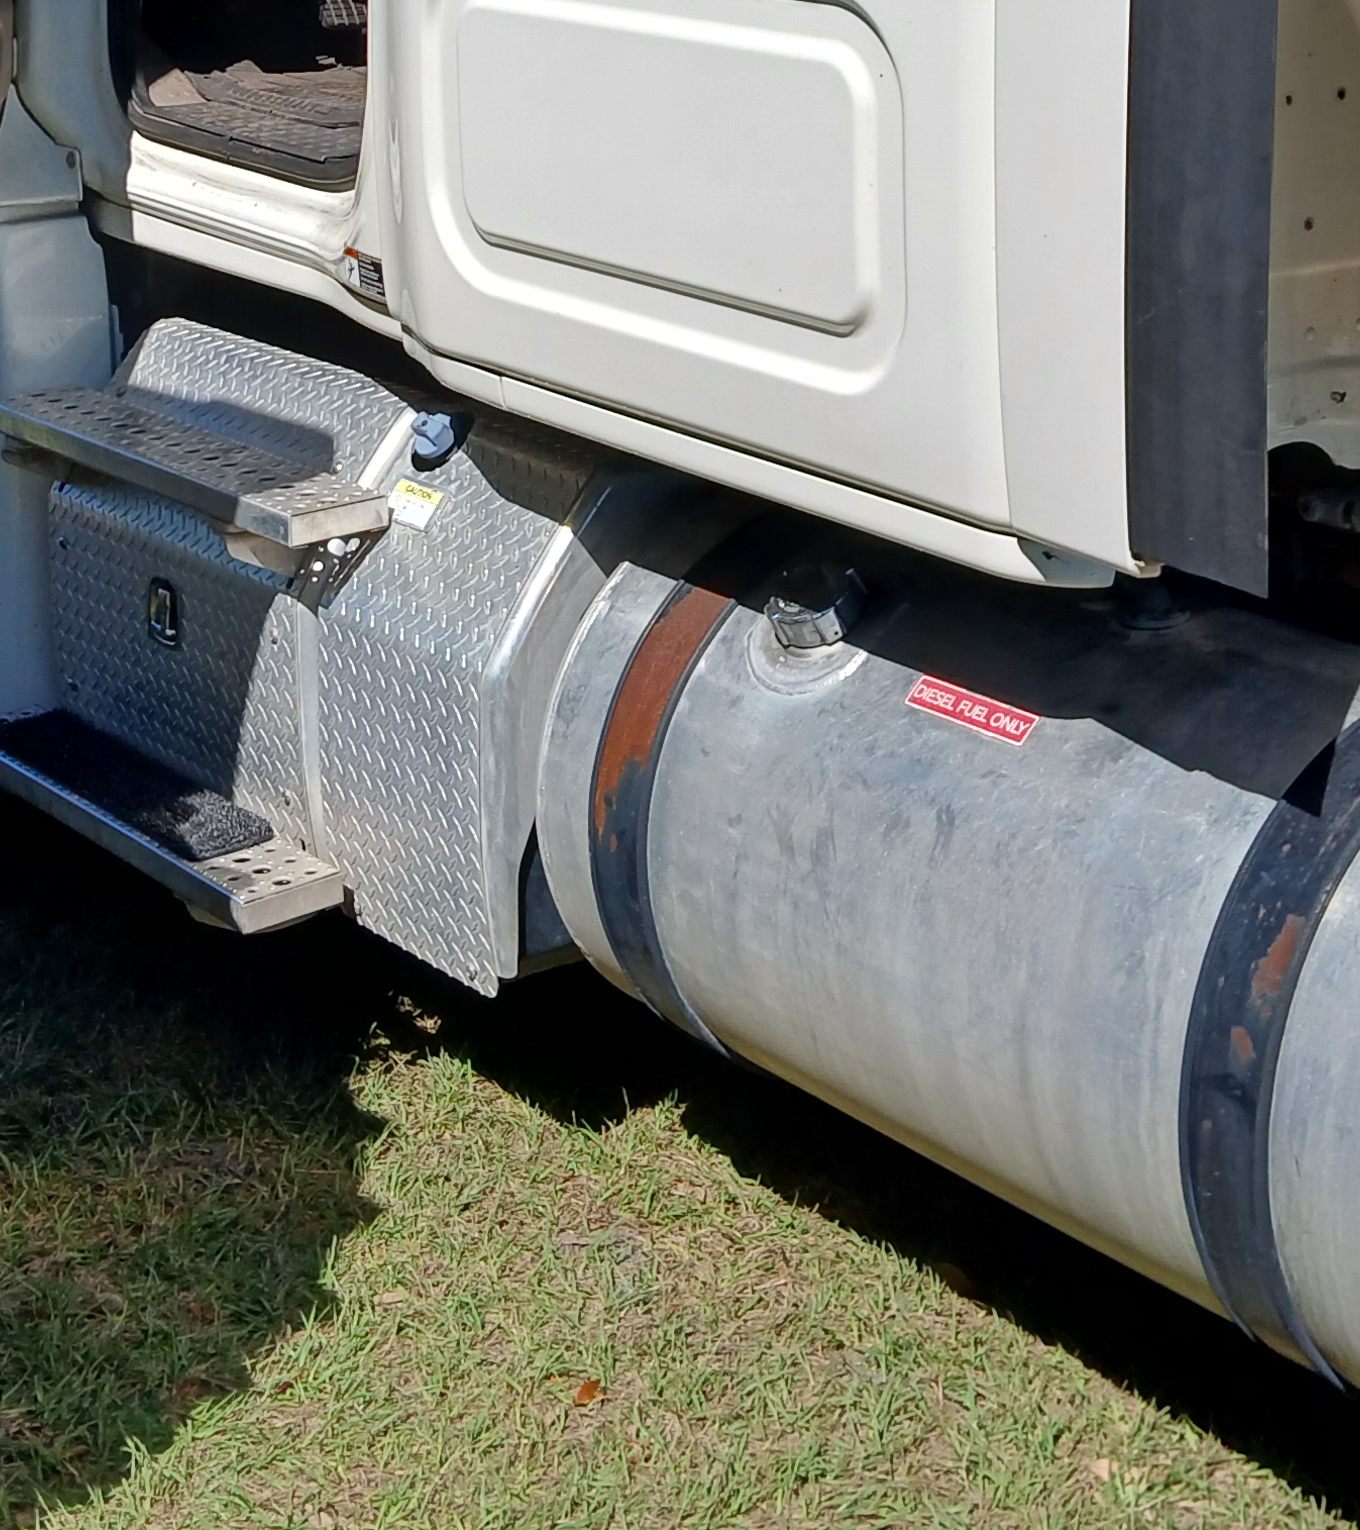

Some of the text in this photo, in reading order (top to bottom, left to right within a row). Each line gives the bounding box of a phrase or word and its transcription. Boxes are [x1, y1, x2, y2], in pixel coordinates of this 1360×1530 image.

[406, 485, 432, 499] CAUTION
[914, 684, 1031, 735] DIESEL FUEL ONLY
